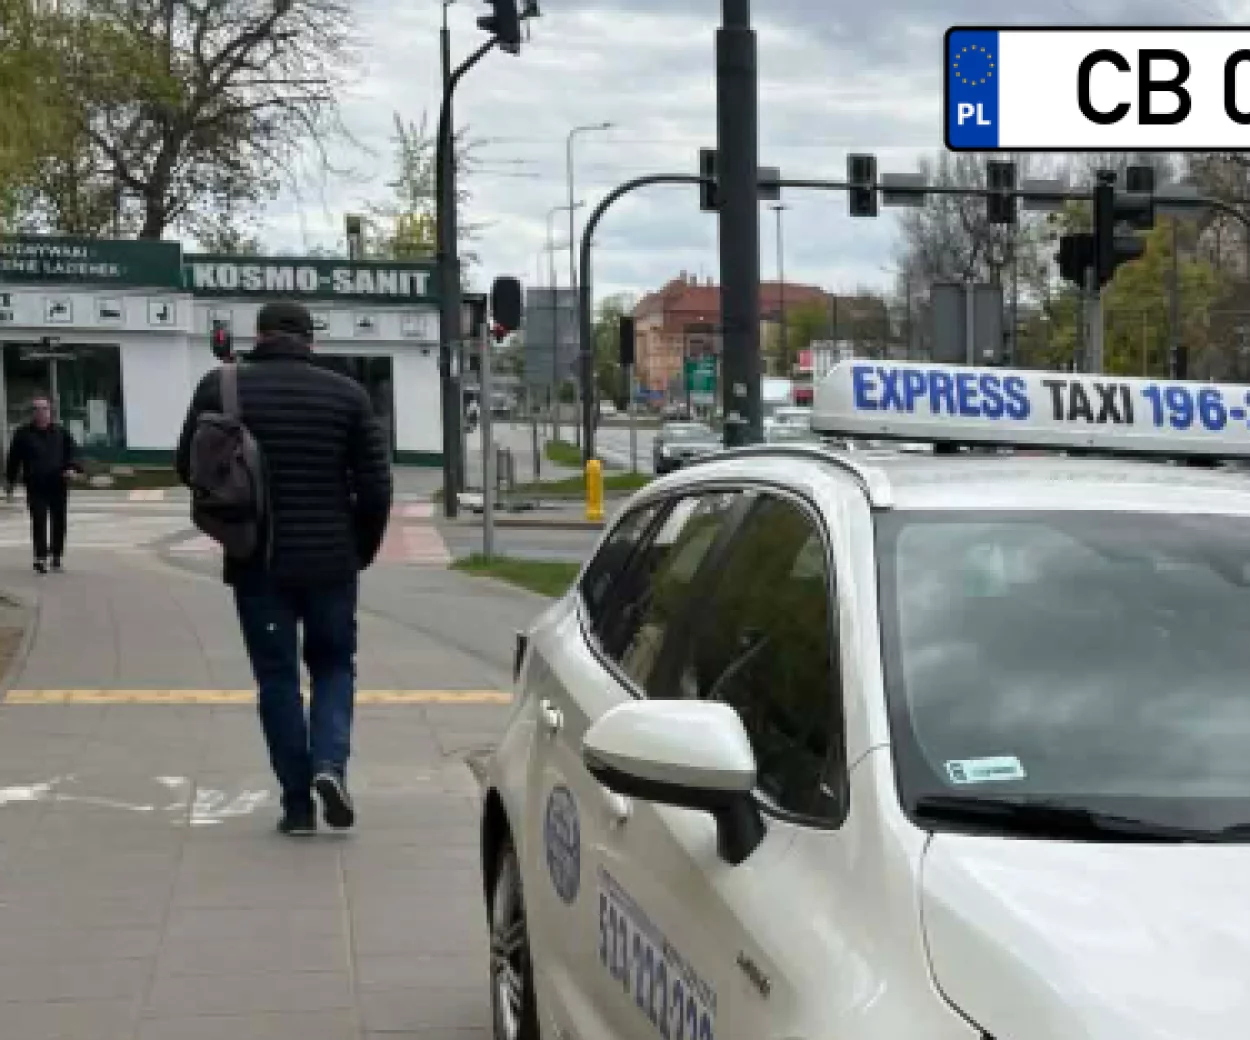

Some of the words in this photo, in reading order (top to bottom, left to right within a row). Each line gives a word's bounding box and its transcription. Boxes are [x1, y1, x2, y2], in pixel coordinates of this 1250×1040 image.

[192, 263, 431, 296] KOSMO-SANIT
[852, 366, 1030, 420] EXPRESS
[1043, 379, 1134, 425] TAXI
